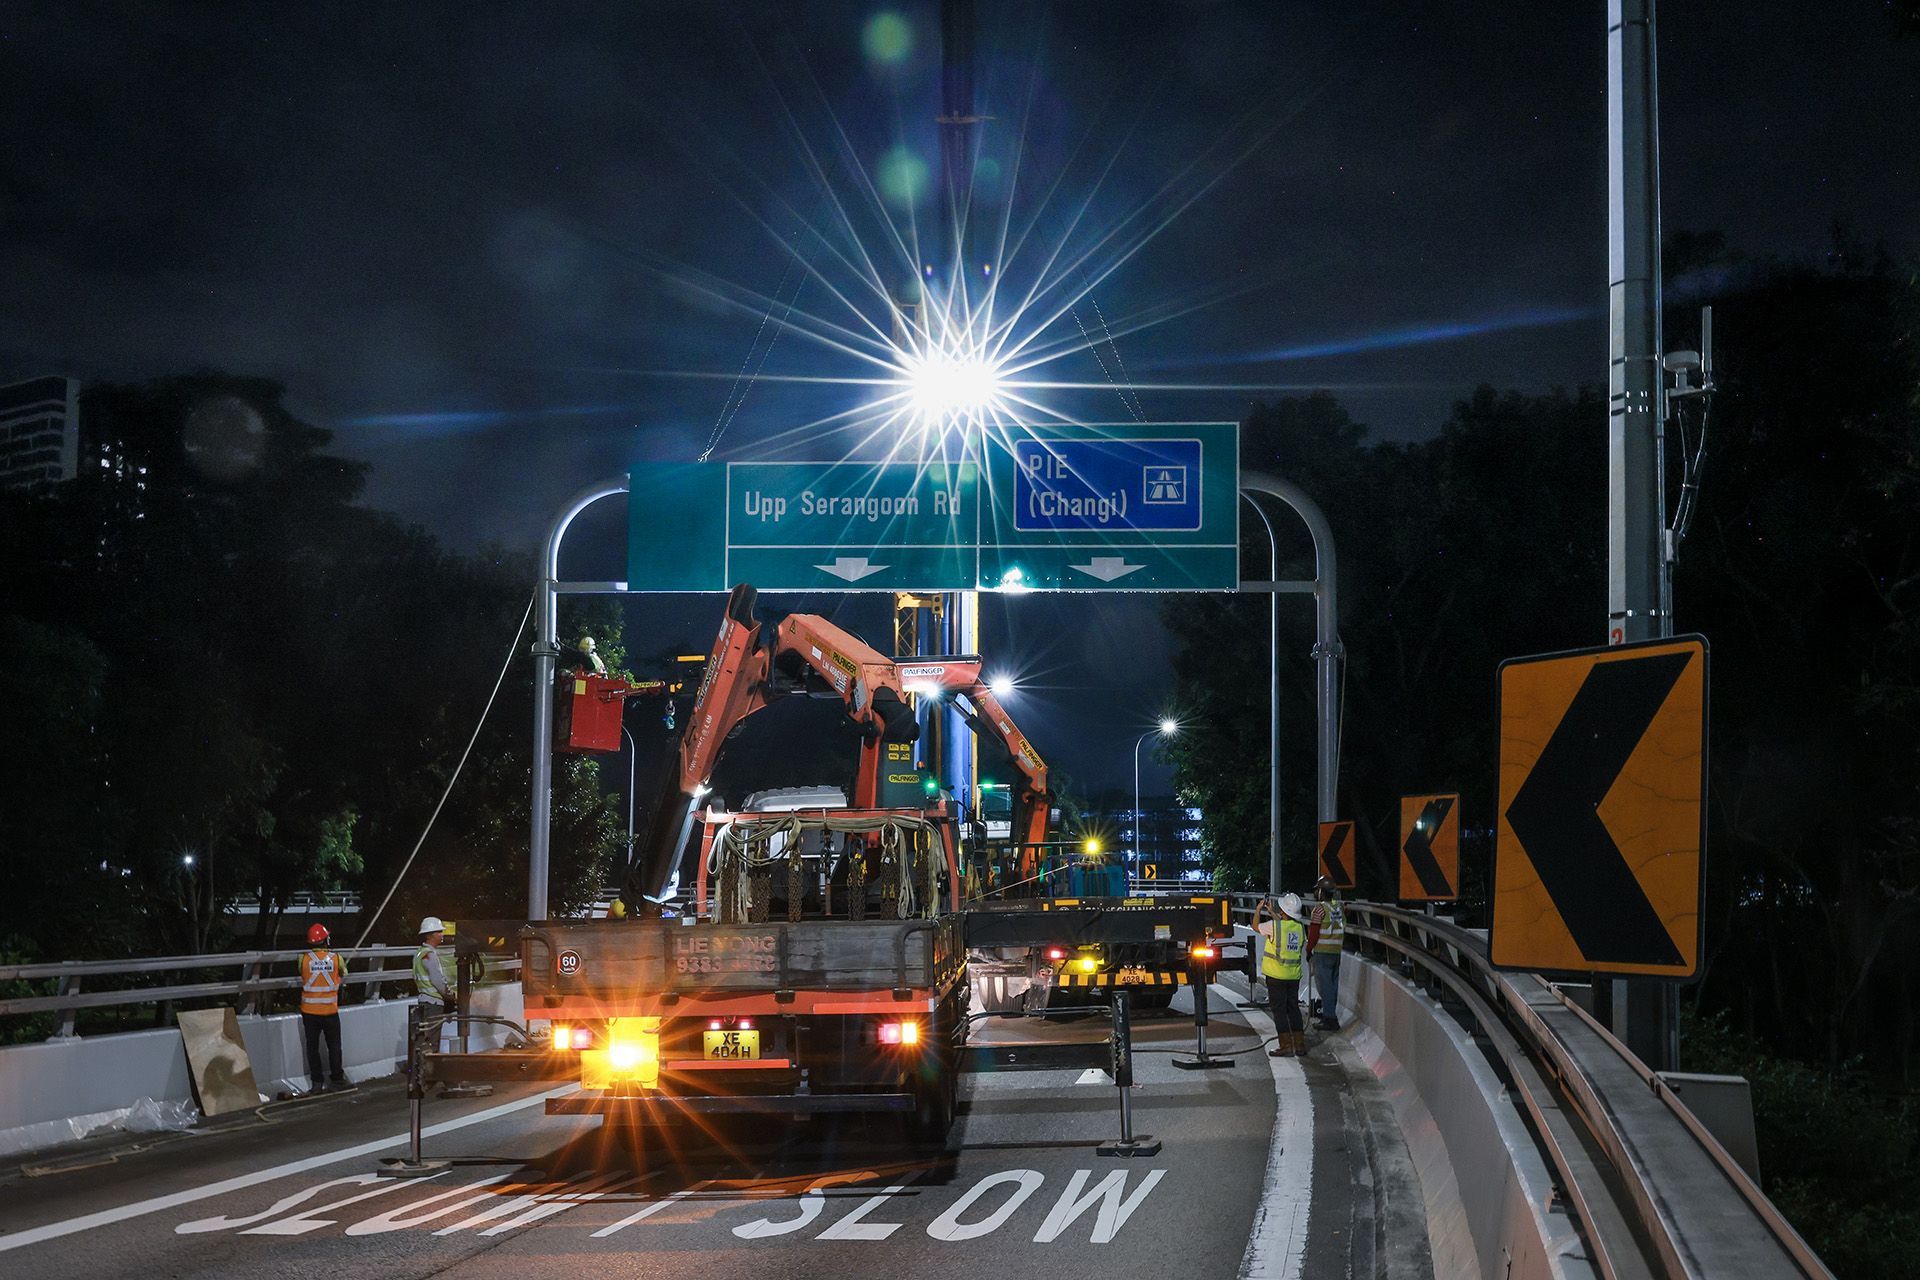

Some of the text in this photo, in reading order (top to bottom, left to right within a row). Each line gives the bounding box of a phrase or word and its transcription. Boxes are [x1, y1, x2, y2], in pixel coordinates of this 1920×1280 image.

[1029, 453, 1067, 479] PIE
[745, 490, 961, 522] Upp Serangoon Rd
[1029, 488, 1127, 524] (Changi)
[831, 651, 858, 676] PALFINGER
[903, 667, 943, 675] PALFINGER
[1019, 740, 1043, 770] PALFINGER
[677, 937, 709, 954] LIE
[562, 956, 576, 967] 60
[722, 1032, 741, 1046] XE
[732, 1169, 1168, 1243] SLOW
